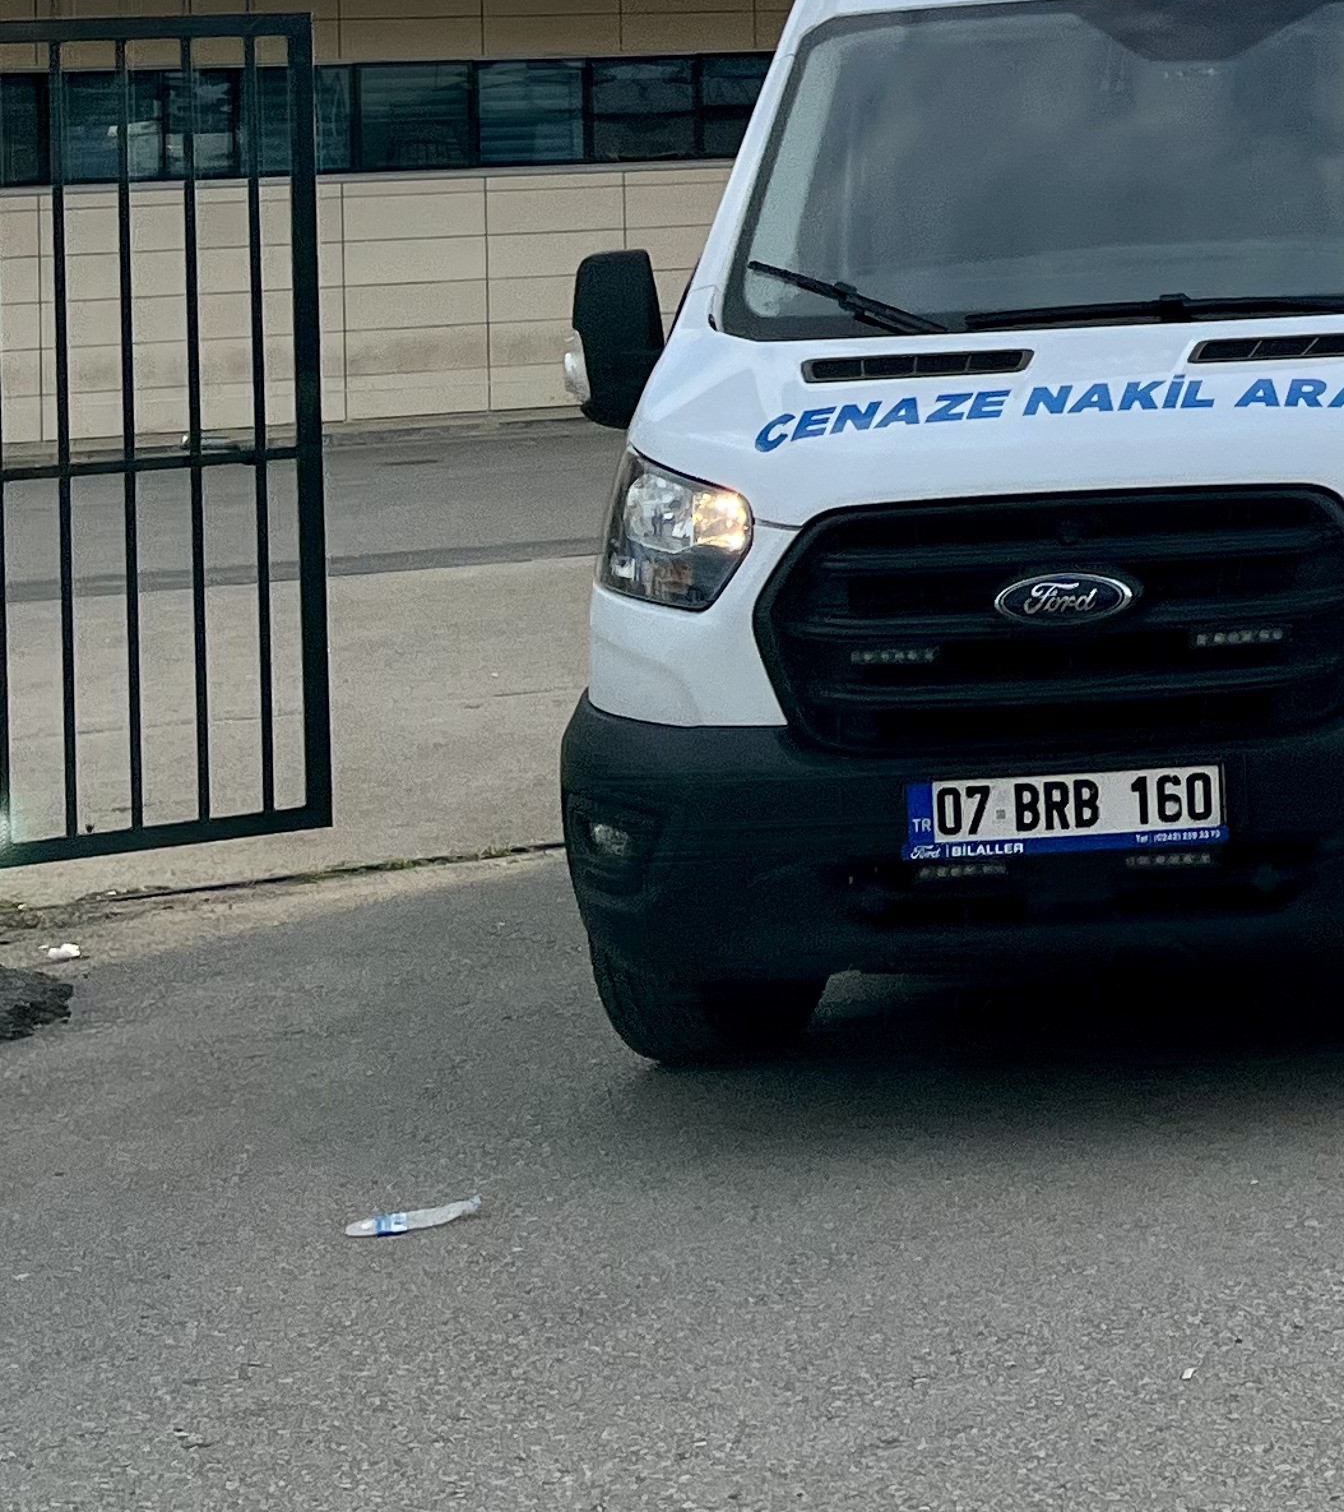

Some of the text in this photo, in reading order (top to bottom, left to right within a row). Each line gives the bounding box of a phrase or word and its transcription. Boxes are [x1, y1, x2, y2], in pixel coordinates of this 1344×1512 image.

[755, 389, 1011, 453] CENAZE
[1023, 374, 1216, 417] NAKİL
[1023, 582, 1099, 615] Ford
[912, 772, 1212, 836] TR 07 BRB 160
[910, 845, 941, 860] Ford
[951, 842, 1024, 857] BİLALLER
